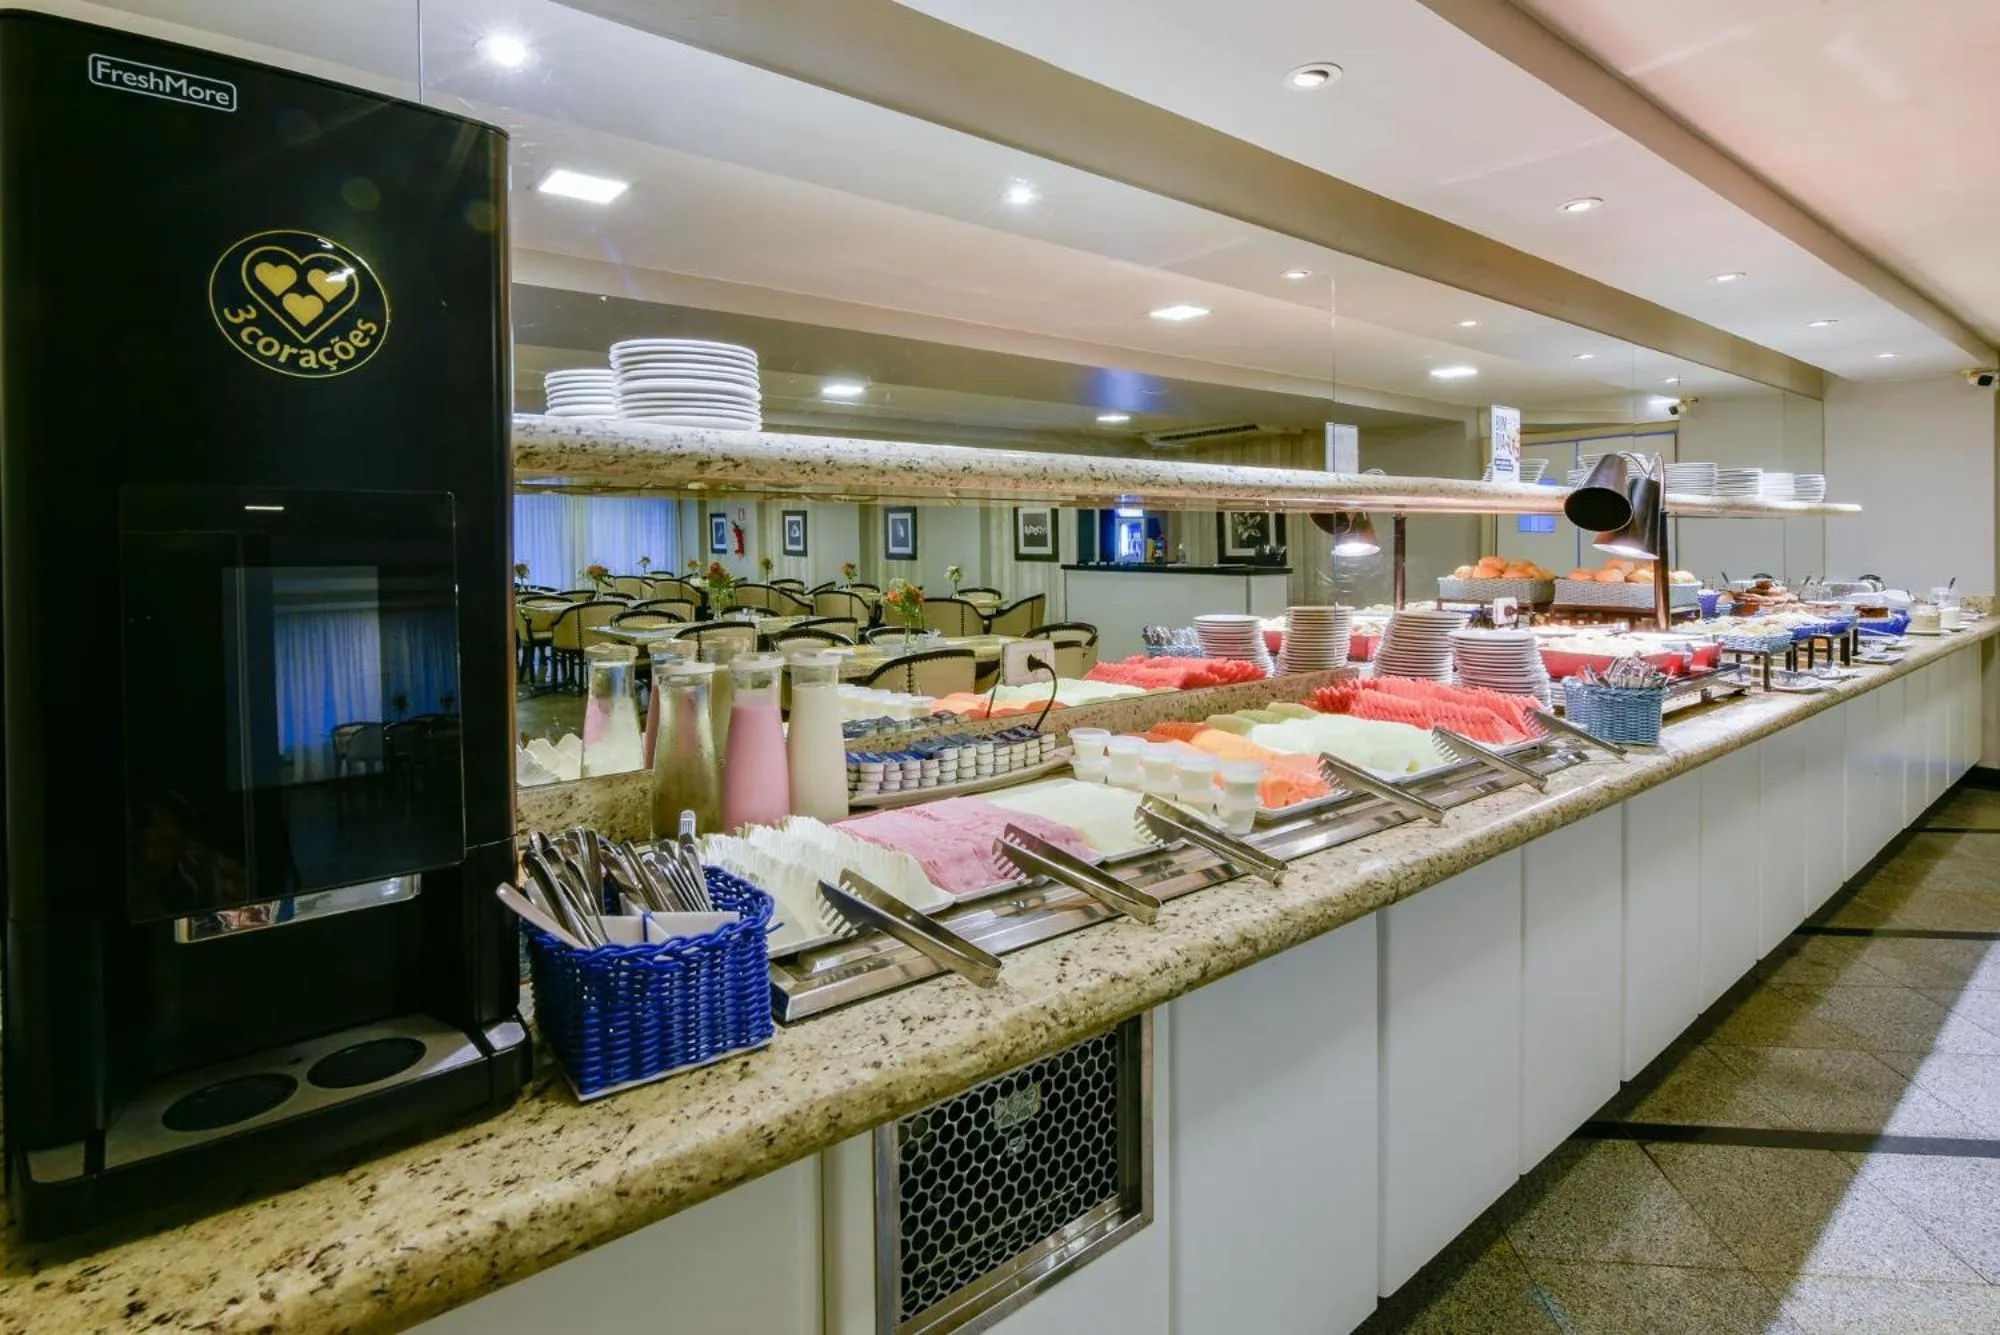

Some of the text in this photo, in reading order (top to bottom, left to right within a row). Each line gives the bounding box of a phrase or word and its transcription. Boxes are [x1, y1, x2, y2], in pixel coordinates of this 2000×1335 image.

[96, 60, 230, 106] FreshMore
[223, 303, 378, 371] 3 corações
